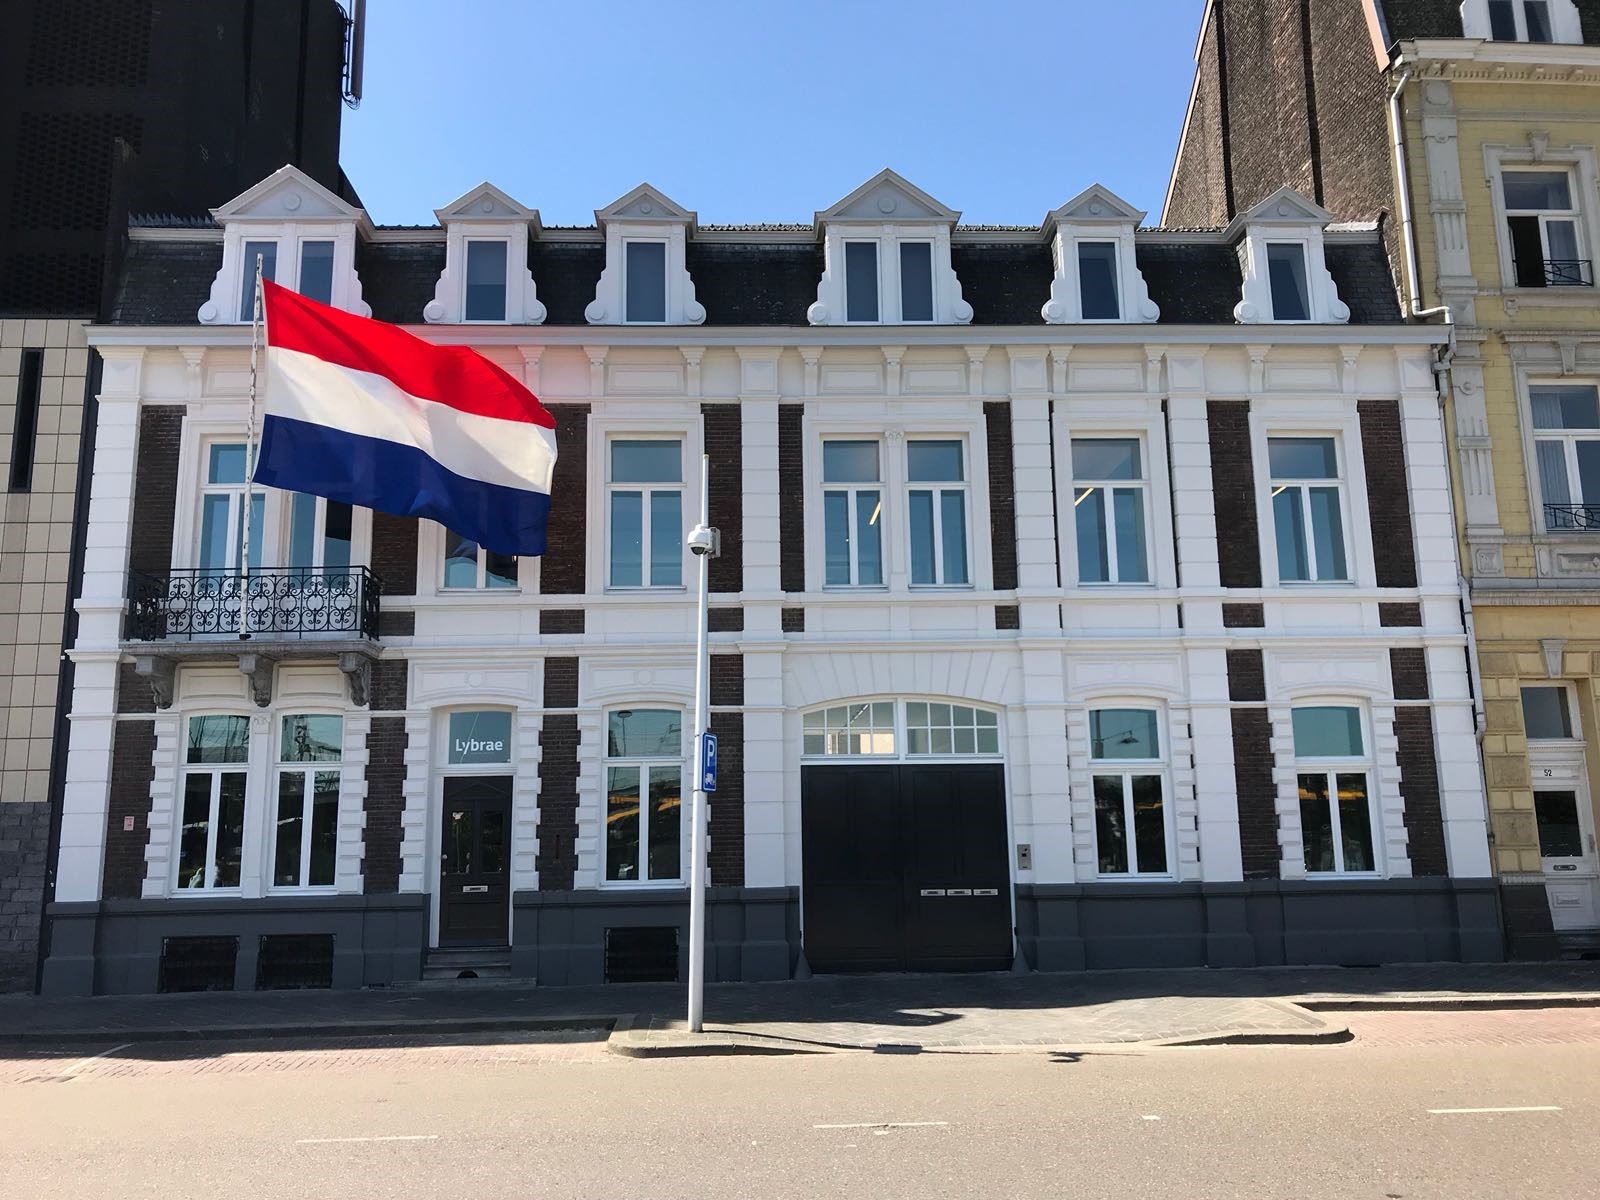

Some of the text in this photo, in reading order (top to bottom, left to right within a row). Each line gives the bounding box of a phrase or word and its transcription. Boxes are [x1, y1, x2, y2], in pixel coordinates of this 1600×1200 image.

[455, 738, 503, 755] Lybrae
[707, 739, 715, 767] P
[1543, 768, 1553, 777] 52
